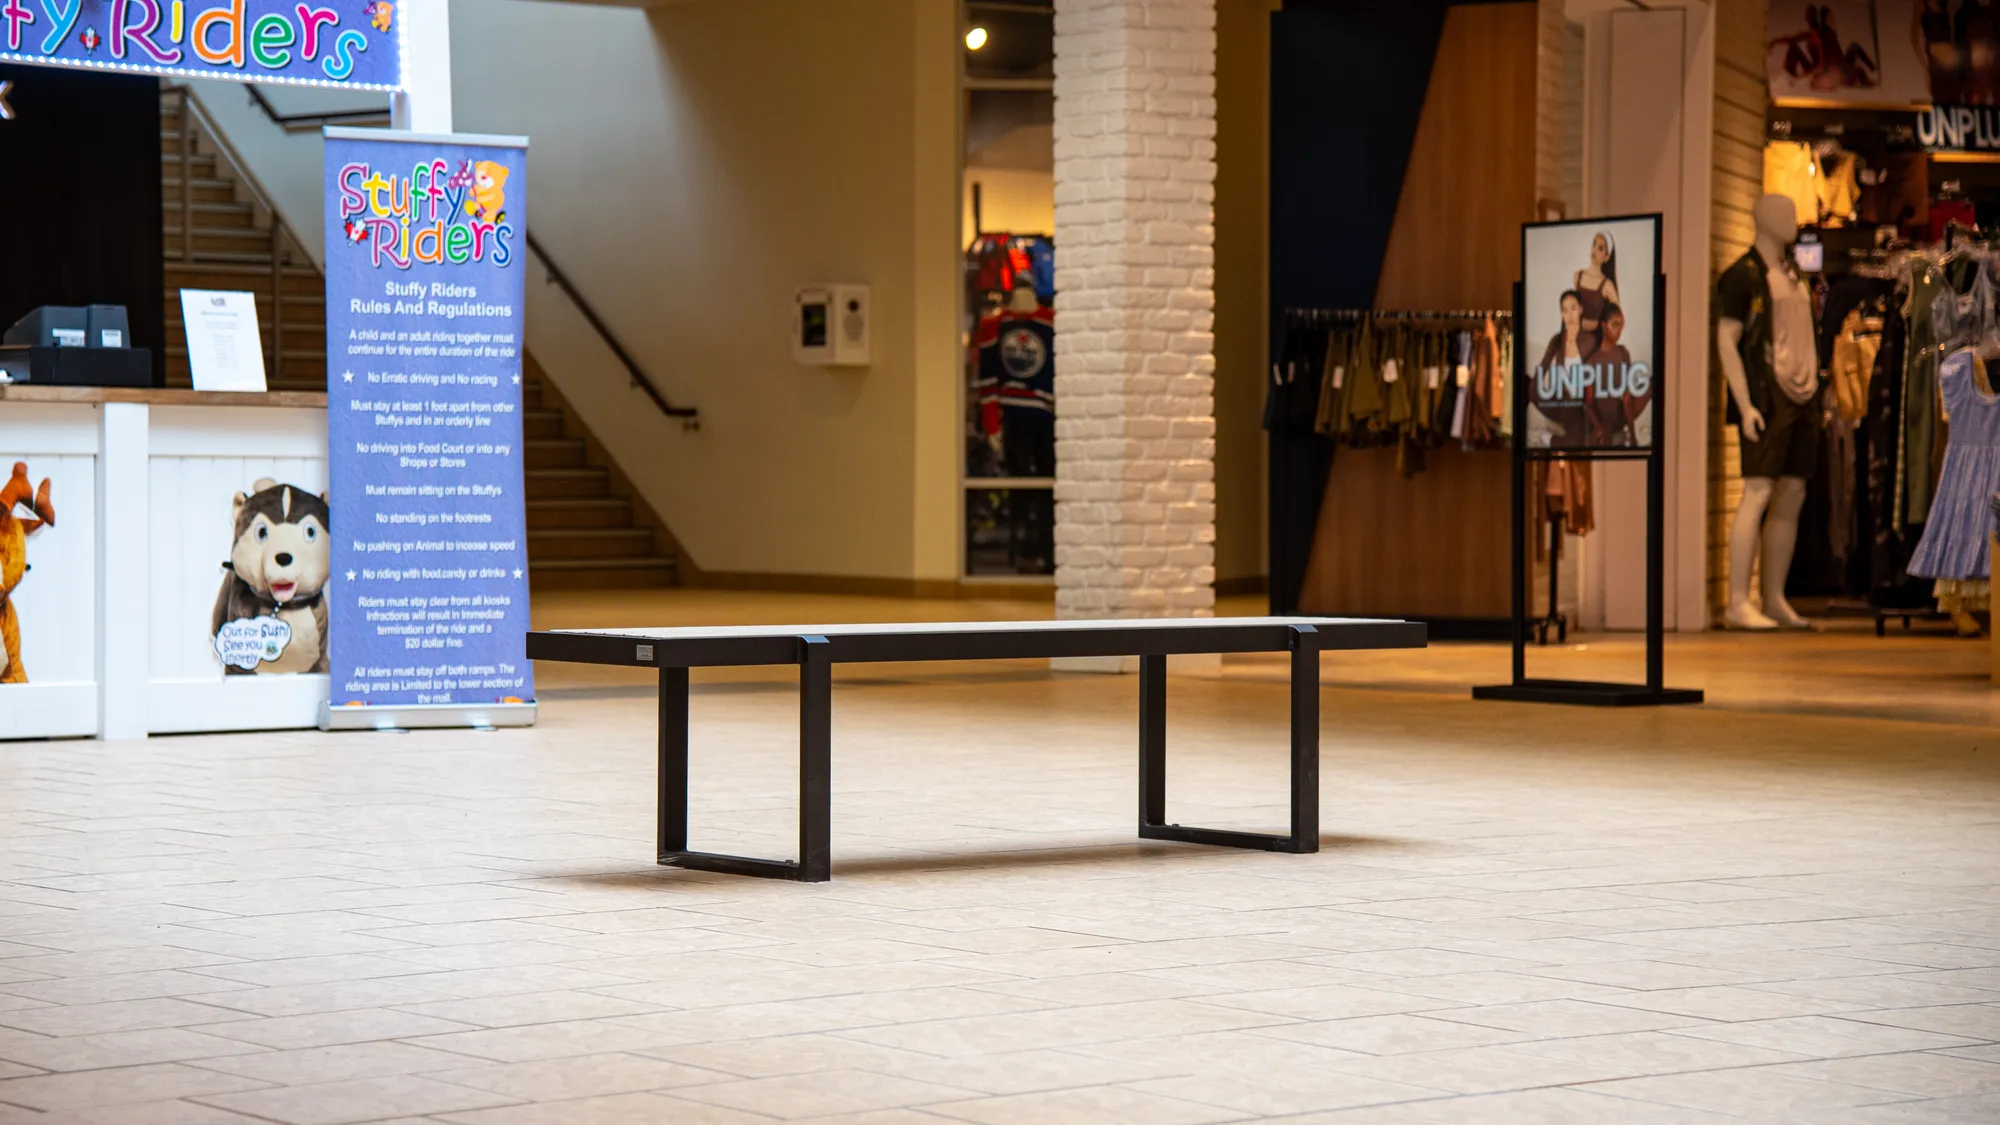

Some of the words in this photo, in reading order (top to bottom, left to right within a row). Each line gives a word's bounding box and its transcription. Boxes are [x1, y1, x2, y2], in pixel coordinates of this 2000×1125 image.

[110, 0, 367, 79] Riders
[338, 158, 466, 228] Stuffy
[365, 217, 513, 269] Riders
[385, 281, 427, 299] Stuffy
[431, 282, 477, 298] Riders
[351, 299, 391, 314] Rules
[394, 300, 424, 315] And
[428, 301, 512, 319] Regulations
[349, 328, 357, 340] A
[358, 329, 379, 341] child
[380, 330, 396, 342] and
[397, 332, 408, 342] an
[409, 330, 431, 342] adult
[432, 331, 456, 345] riding
[457, 332, 491, 345] together
[493, 333, 514, 344] must
[348, 344, 384, 355] continue
[385, 343, 397, 356] for
[399, 344, 412, 356] the
[413, 345, 438, 356] entire
[439, 345, 473, 357] duration
[474, 345, 484, 357] of
[484, 346, 499, 358] the
[500, 347, 516, 358] ride
[367, 371, 381, 384] No
[381, 371, 408, 384] Erratic
[409, 372, 439, 387] driving
[440, 373, 456, 385] and
[457, 374, 470, 385] No
[471, 375, 498, 387] racing
[1537, 362, 1651, 400] UNPLUG
[351, 400, 372, 411] Must
[373, 402, 391, 414] stay
[392, 401, 401, 411] at
[402, 401, 422, 412] least
[431, 401, 448, 412] foot
[448, 402, 470, 414] apart
[470, 401, 491, 413] from
[492, 402, 515, 413] other
[375, 414, 404, 428] Stuffys
[405, 415, 422, 426] and
[423, 414, 433, 426] in
[433, 416, 444, 426] an
[445, 415, 474, 429] orderly
[475, 416, 491, 427] line
[356, 442, 370, 453] No
[370, 442, 399, 456] driving
[400, 442, 417, 454] into
[418, 442, 440, 454] Food
[441, 443, 464, 454] Court
[465, 445, 476, 454] or
[476, 443, 494, 455] into
[494, 445, 511, 456] any
[400, 456, 428, 470] Shops
[429, 458, 439, 468] or
[440, 456, 467, 468] Stores
[365, 485, 386, 496] Must
[388, 485, 417, 496] remain
[418, 484, 444, 498] sitting
[445, 487, 456, 496] on
[457, 485, 471, 496] the
[472, 485, 502, 498] Stuffys
[375, 513, 388, 524] No
[390, 512, 426, 526] standing
[427, 515, 439, 524] on
[440, 513, 454, 524] the
[455, 513, 492, 524] footrests
[353, 540, 366, 552] No
[367, 541, 401, 554] pushing
[402, 543, 414, 552] on
[415, 540, 445, 551] Animal
[445, 541, 454, 551] to
[489, 540, 516, 553] speed
[363, 568, 375, 580] No
[377, 568, 401, 582] riding
[402, 568, 420, 580] with
[468, 569, 478, 579] or
[479, 567, 506, 578] drinks
[358, 596, 385, 608] Riders
[387, 597, 409, 608] must
[410, 596, 428, 609] stay
[429, 596, 449, 606] clear
[451, 595, 470, 606] from
[472, 595, 482, 606] all
[483, 595, 511, 606] kiosks
[366, 610, 410, 621] Infractions
[411, 610, 426, 621] will
[427, 609, 451, 620] result
[452, 609, 460, 620] in
[223, 627, 242, 638] Out
[245, 627, 258, 638] for
[261, 624, 289, 638] Sushi
[377, 624, 425, 636] termination
[426, 623, 435, 634] of
[436, 623, 449, 635] the
[450, 623, 467, 634] ride
[468, 622, 485, 634] and
[223, 640, 244, 652] See
[245, 640, 263, 651] you
[405, 638, 420, 649] $20
[421, 637, 445, 649] dollar
[225, 653, 258, 665] shortly
[354, 666, 366, 678] All
[367, 667, 392, 678] riders
[393, 667, 415, 677] must
[416, 666, 434, 679] stay
[435, 664, 448, 676] off
[448, 664, 468, 676] both
[499, 664, 516, 675] The
[345, 681, 371, 694] riding
[372, 682, 390, 692] area
[392, 680, 400, 691] is
[401, 679, 433, 691] Limited
[433, 679, 443, 690] to
[443, 679, 457, 690] the
[459, 679, 482, 689] lower
[483, 679, 513, 689] section
[514, 677, 524, 688] of
[418, 694, 432, 704] the
